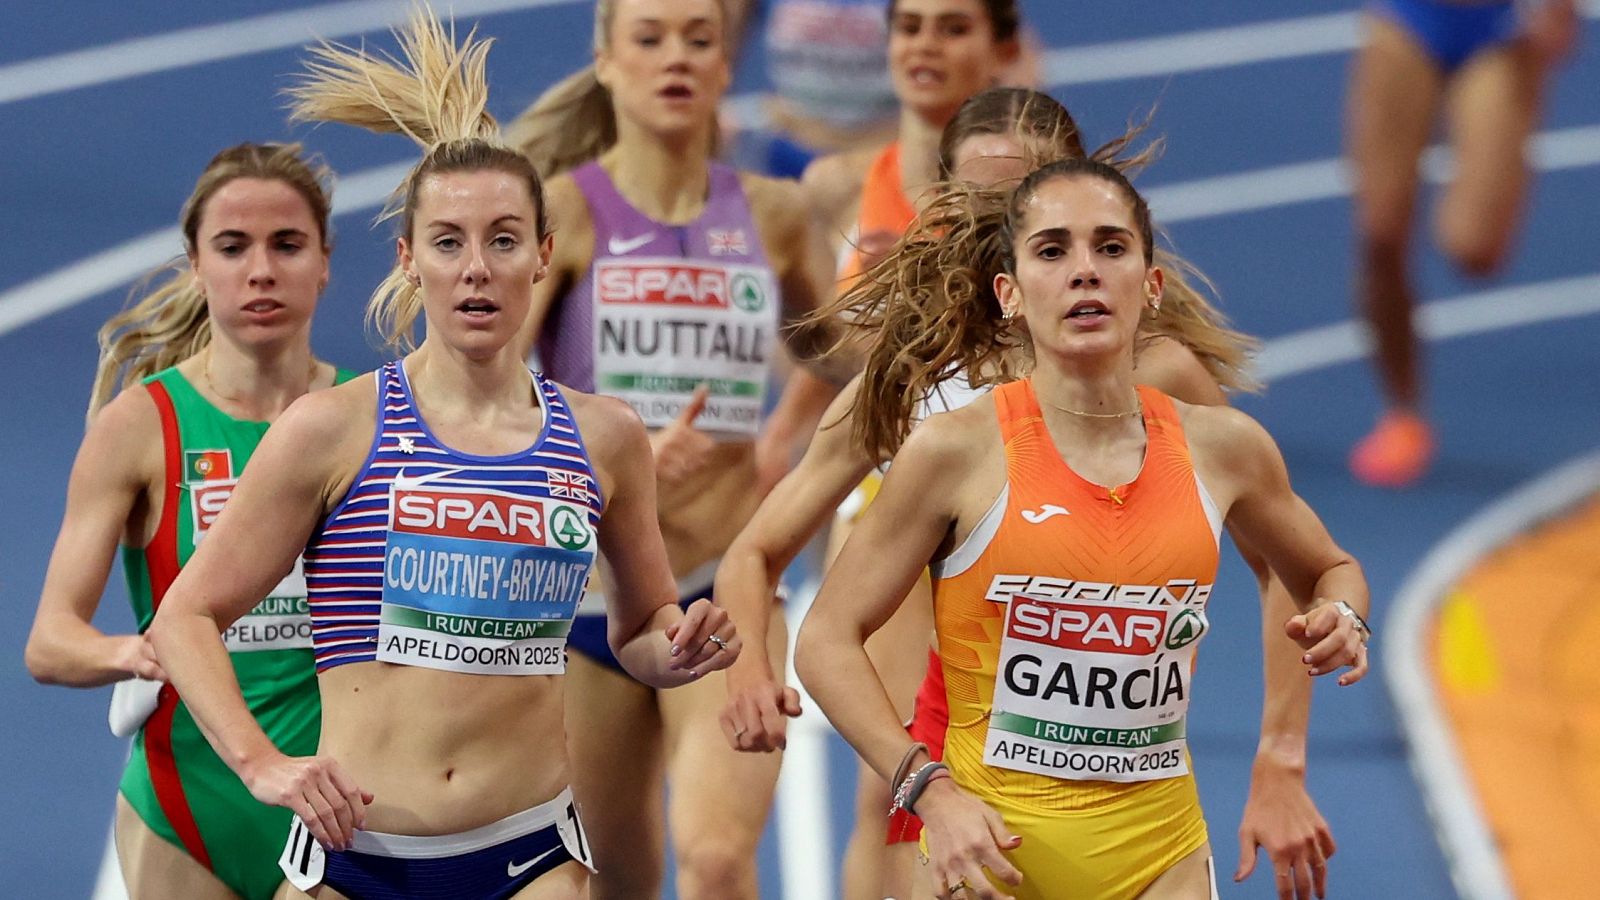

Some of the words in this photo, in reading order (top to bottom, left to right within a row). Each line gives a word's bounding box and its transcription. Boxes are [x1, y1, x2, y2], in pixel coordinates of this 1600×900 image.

[601, 268, 724, 304] SPAR
[601, 319, 764, 363] NUTTALL
[398, 496, 542, 540] SPAR
[386, 545, 588, 603] COURTNEY-BRYANT
[223, 623, 313, 643] PELDOO
[426, 614, 432, 629] I
[435, 616, 479, 635] RUN
[1012, 603, 1162, 648] SPAR
[386, 635, 521, 666] APELDOORN
[524, 647, 560, 666] 2025
[1003, 653, 1184, 710] GARCÍA
[1034, 721, 1041, 736] I
[1044, 723, 1088, 743] RUN
[992, 740, 1136, 774] APELDOORN
[1139, 749, 1181, 772] 2025
